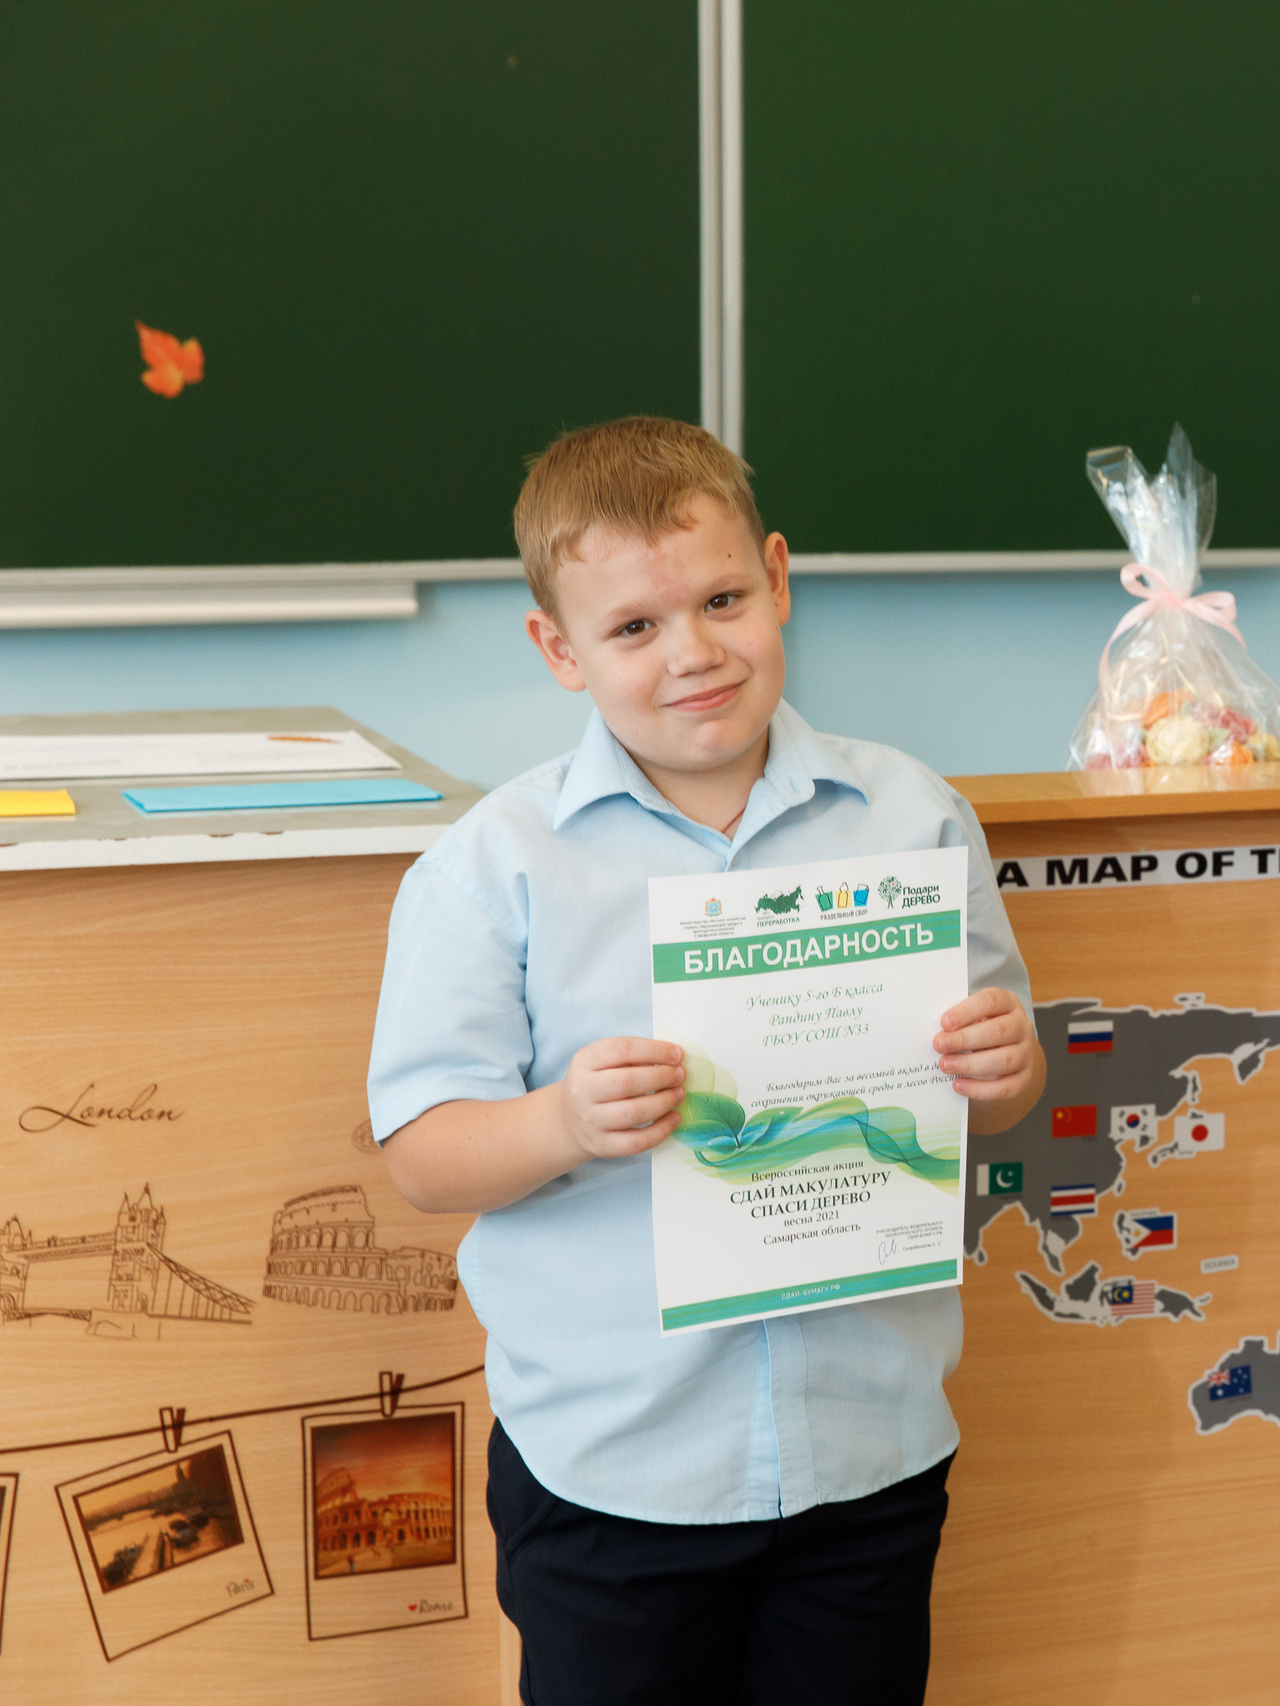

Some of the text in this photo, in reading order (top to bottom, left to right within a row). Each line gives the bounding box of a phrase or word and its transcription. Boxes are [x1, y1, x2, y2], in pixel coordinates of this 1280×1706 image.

[997, 861, 1029, 889] A
[1045, 854, 1160, 887] MAP
[1174, 849, 1235, 879] OF
[901, 894, 941, 909] ДЕРЕВО
[902, 885, 940, 896] Подари
[757, 917, 801, 928] ПЕРЕРАБОТКА
[820, 910, 854, 921] РАЗДЕЛЬНЫЙ
[684, 922, 934, 974] БЛАГОДАРНОСТЬ
[746, 984, 883, 1011] Ученику 5-го Б класса
[769, 1006, 863, 1026] Рандину Павлу
[762, 1030, 805, 1047] ГБОУ
[805, 1025, 843, 1043] СОШ
[766, 1079, 823, 1092] Благодарим
[825, 1076, 842, 1084] Вас
[857, 1068, 895, 1081] весомый
[898, 1064, 923, 1076] вклад
[751, 1095, 804, 1109] сохранения
[806, 1087, 866, 1102] окружающей
[868, 1082, 894, 1095] среды
[904, 1079, 928, 1088] лесов
[18, 1083, 185, 1133] London
[751, 1160, 864, 1183] Всероссийская акция
[730, 1171, 891, 1205] СДАЙ МАКУЛАТУРУ
[751, 1190, 871, 1219] СПАСИ ДЕРЕВО
[784, 1210, 840, 1227] весна 2021
[763, 1223, 861, 1245] Самарская область
